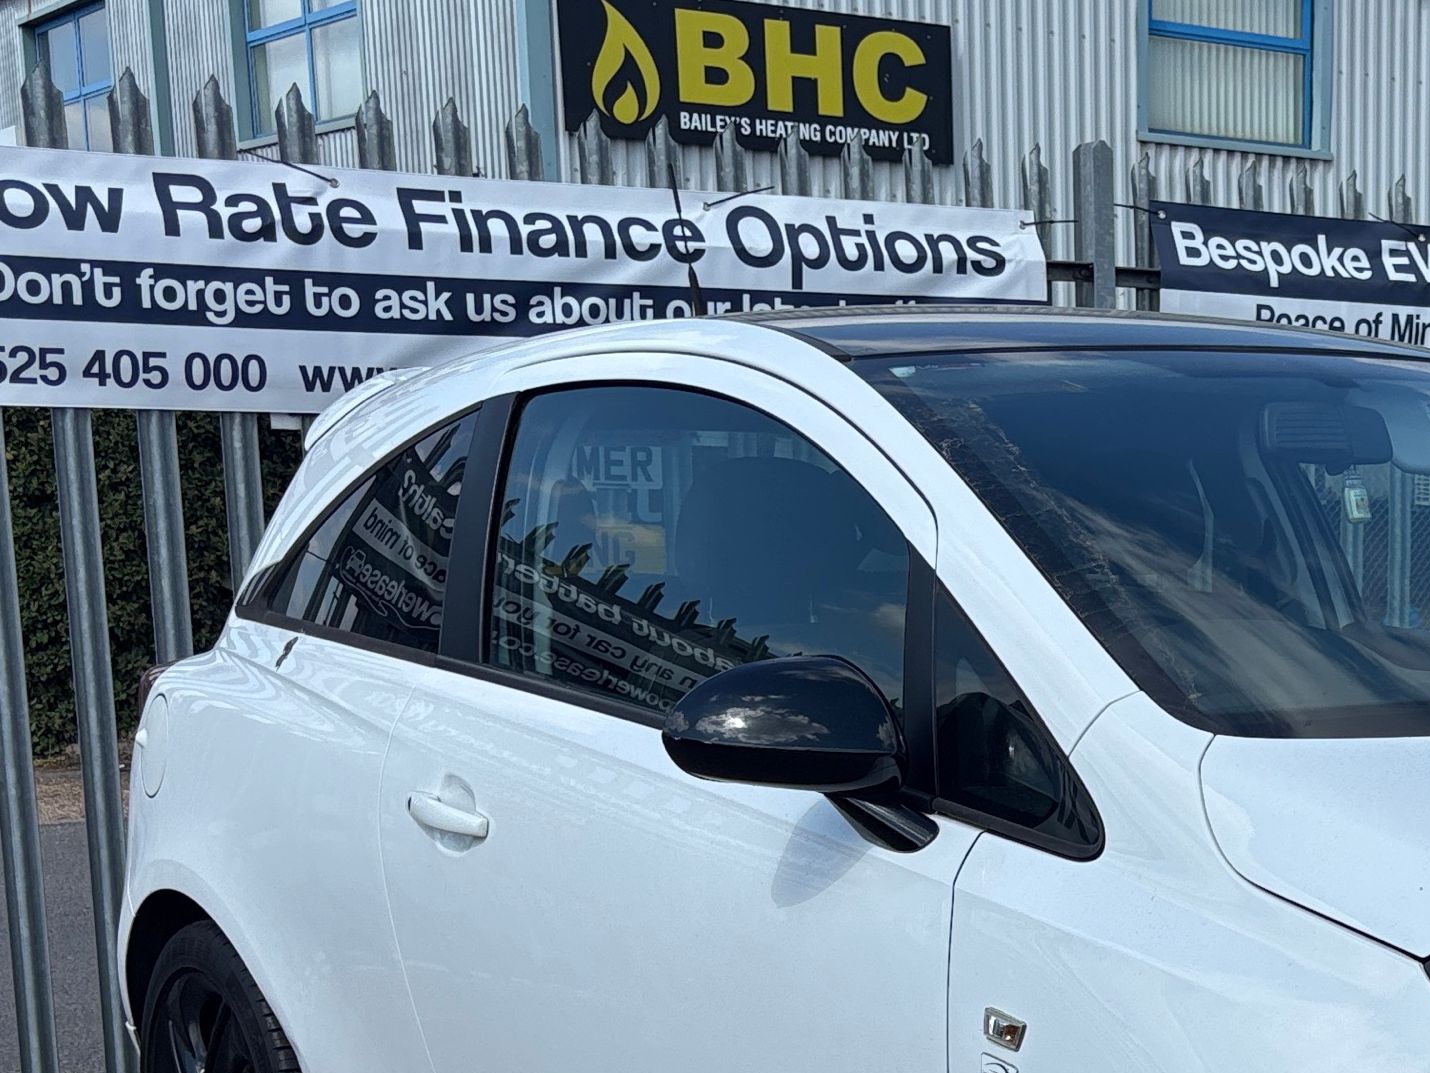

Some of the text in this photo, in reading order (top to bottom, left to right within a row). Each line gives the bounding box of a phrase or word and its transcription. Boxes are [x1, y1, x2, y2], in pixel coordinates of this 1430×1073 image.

[675, 8, 928, 124] BHC
[680, 112, 751, 135] BAILEY'S
[756, 119, 821, 142] HEATNG
[0, 171, 1007, 290] ow Rate Finance Options
[1171, 221, 1373, 288] Bespoke
[135, 267, 291, 325] forget
[304, 278, 361, 319] to
[374, 281, 454, 322] ask
[466, 292, 517, 323] us
[529, 287, 654, 326] about
[1355, 312, 1383, 338] of
[0, 345, 67, 387] 25
[82, 349, 170, 390] 405
[184, 352, 268, 393] 000
[576, 446, 654, 482] MER
